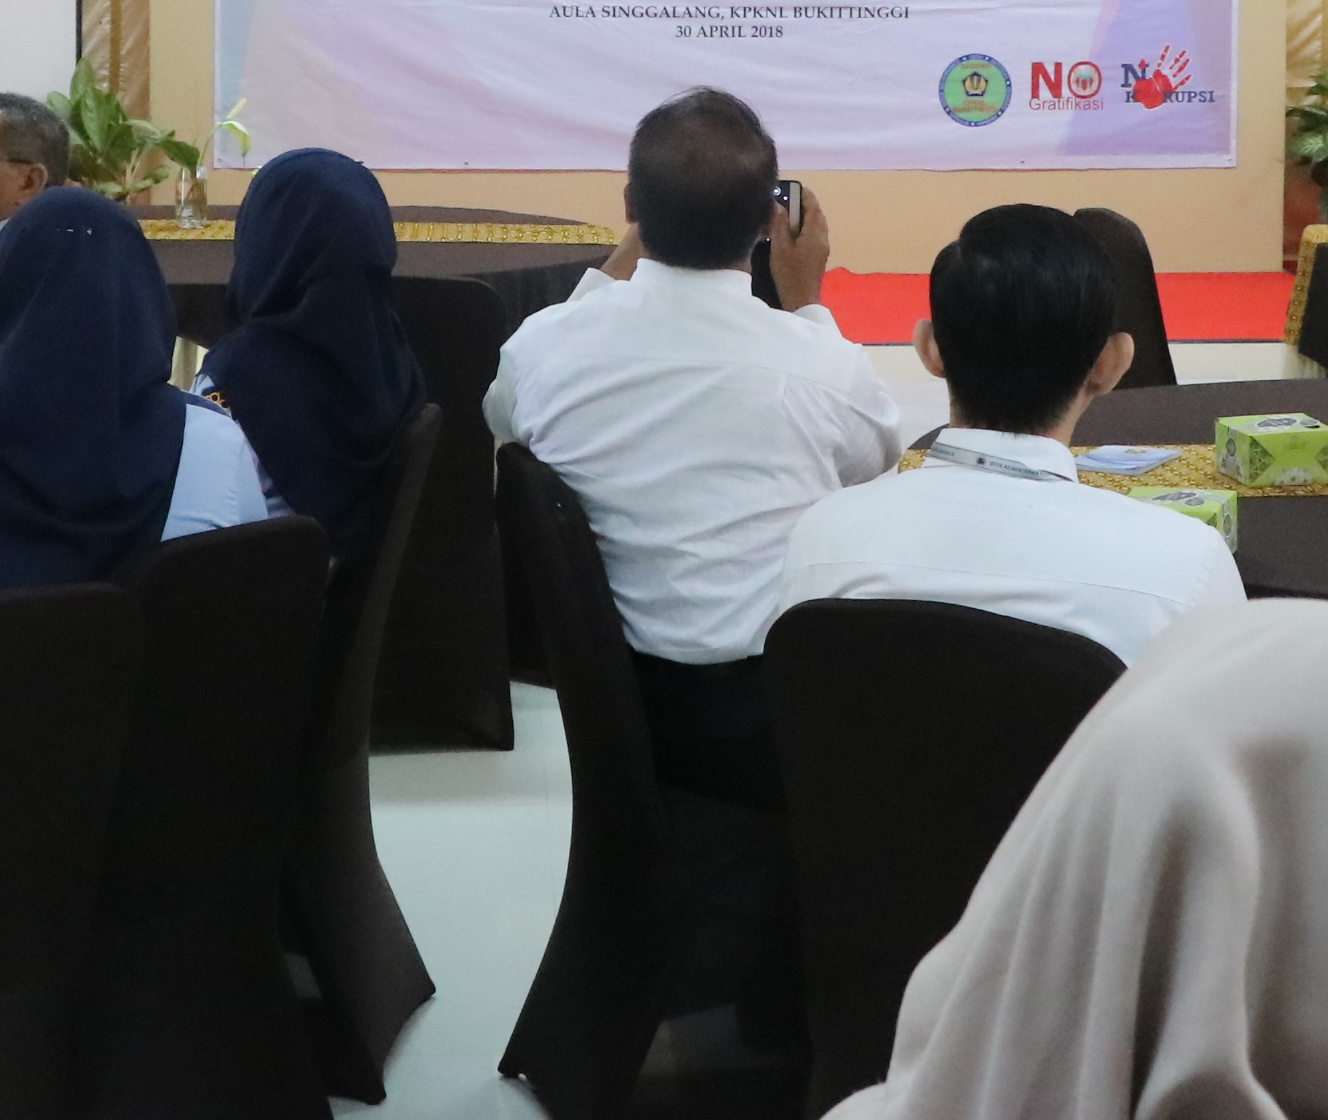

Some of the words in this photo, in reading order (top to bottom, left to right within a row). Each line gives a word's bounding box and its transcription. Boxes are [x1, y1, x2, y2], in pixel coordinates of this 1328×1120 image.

[549, 5, 597, 19] AULA
[601, 5, 726, 21] SINGGALANG,
[729, 6, 789, 19] KPKNL
[793, 6, 910, 20] BUKITTINGGI
[675, 25, 692, 39] 30
[696, 25, 747, 39] APRIL
[751, 25, 784, 39] 2018
[1124, 90, 1216, 103] KRUPSI
[1028, 97, 1104, 112] Gratifikasi
